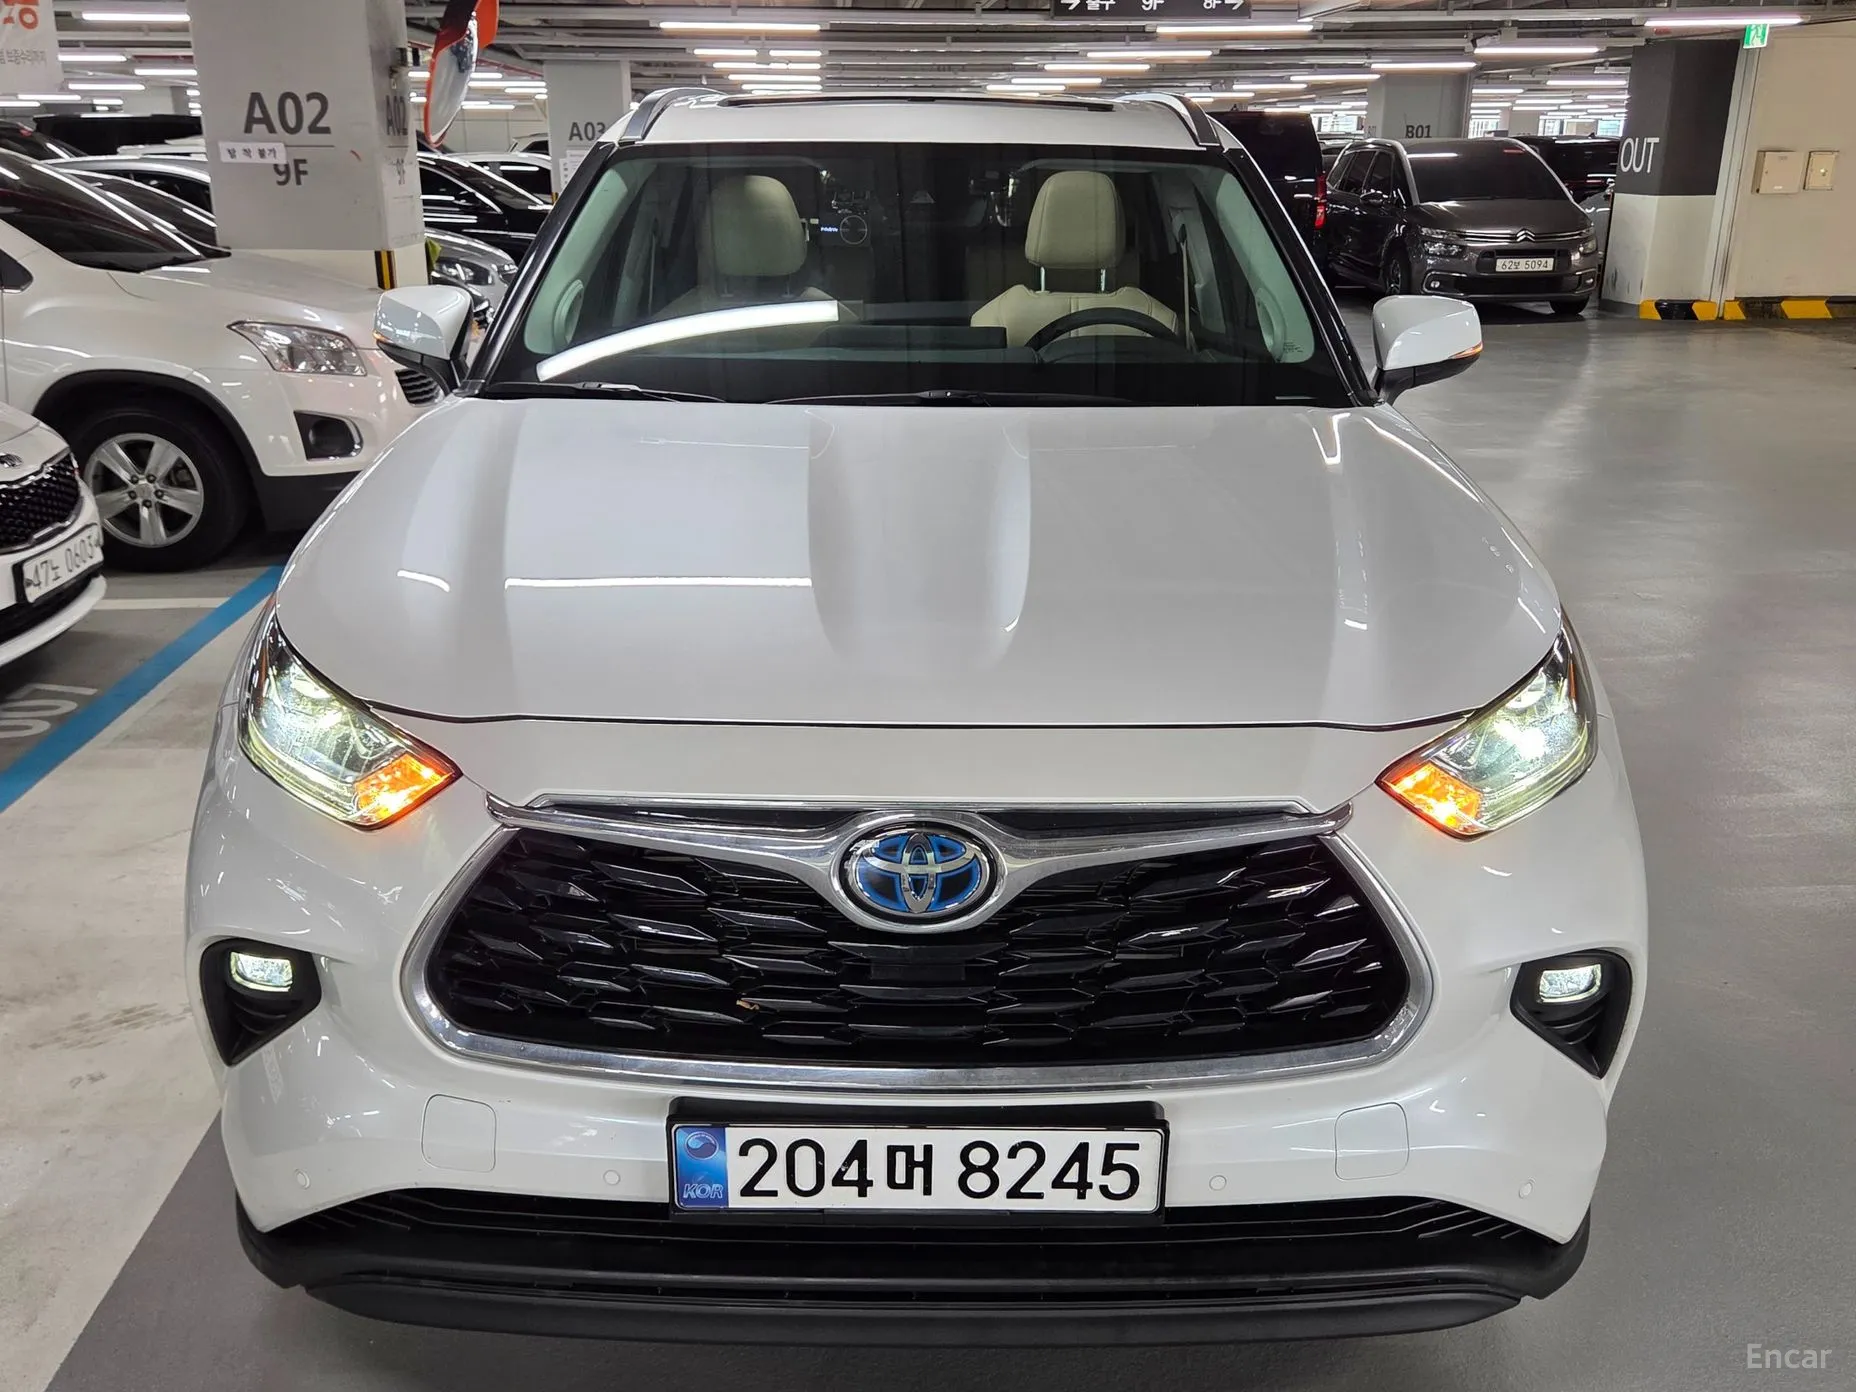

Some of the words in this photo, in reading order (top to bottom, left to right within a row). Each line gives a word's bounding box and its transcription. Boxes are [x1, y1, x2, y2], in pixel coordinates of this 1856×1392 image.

[244, 91, 331, 135] A02
[1405, 124, 1432, 138] B01
[1620, 137, 1660, 173] OUT
[273, 158, 308, 186] 9F
[1524, 259, 1548, 270] 5094
[737, 1137, 933, 1198] 204머
[957, 1140, 1140, 1200] 8245
[683, 1183, 723, 1198] KOR
